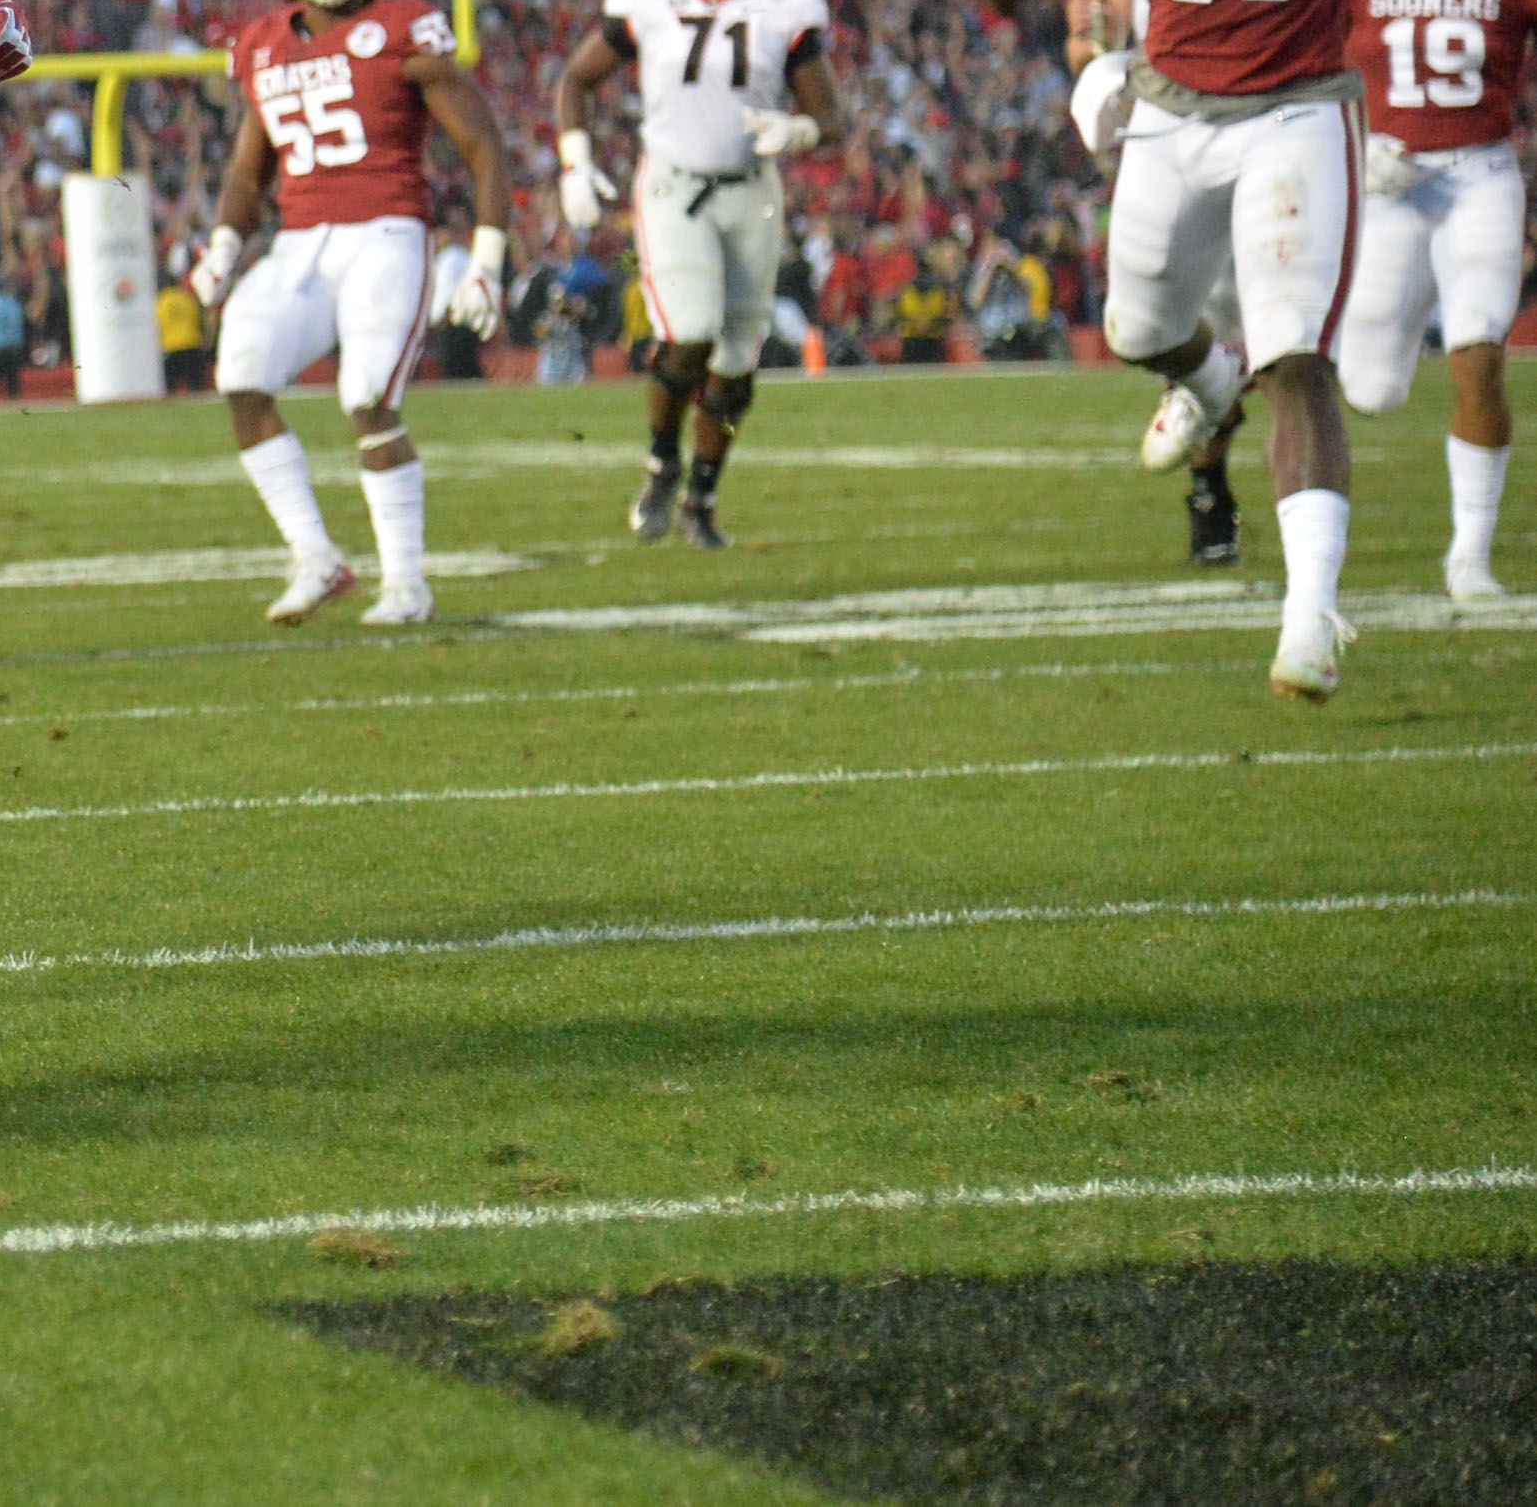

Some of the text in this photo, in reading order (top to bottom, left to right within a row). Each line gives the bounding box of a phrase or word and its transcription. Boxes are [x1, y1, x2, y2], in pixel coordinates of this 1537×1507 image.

[679, 16, 749, 87] 71
[1380, 17, 1486, 109] 19
[260, 83, 369, 176] 55
